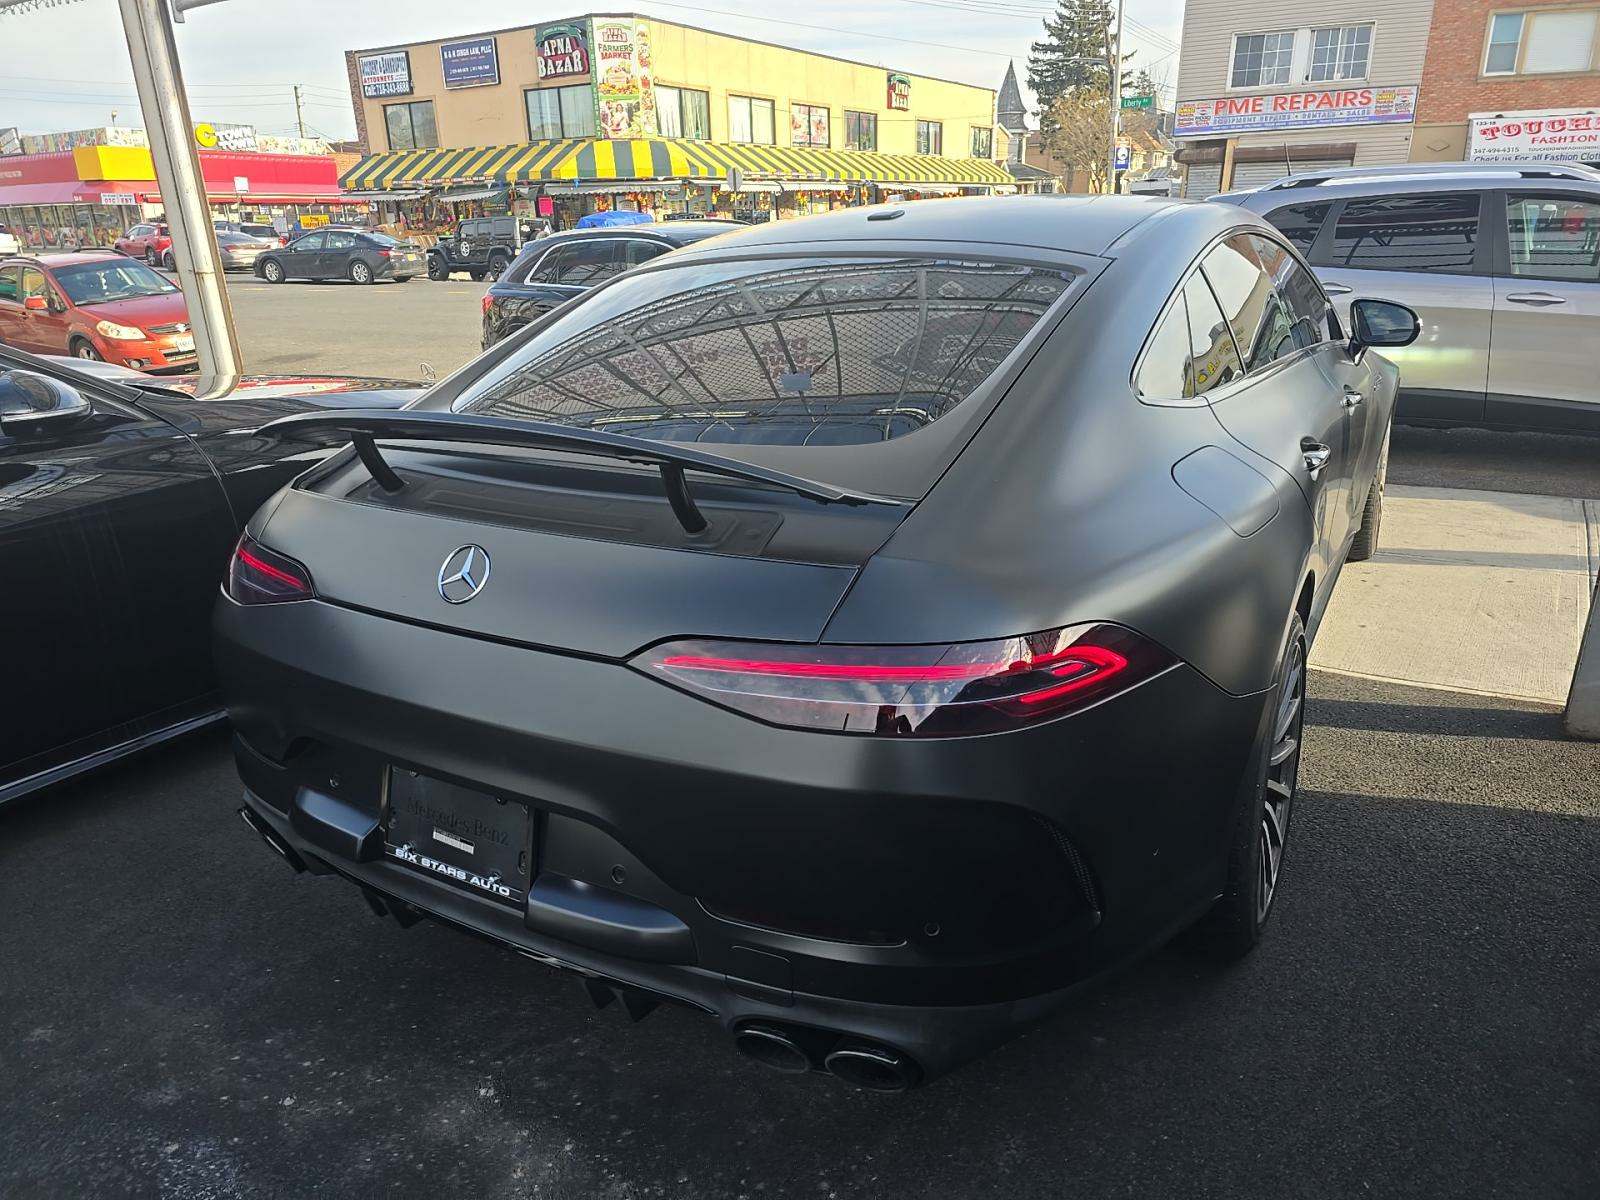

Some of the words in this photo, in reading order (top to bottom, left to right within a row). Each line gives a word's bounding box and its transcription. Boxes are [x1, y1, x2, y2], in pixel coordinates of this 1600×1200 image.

[544, 37, 573, 56] APNA
[598, 43, 634, 52] FARMERS
[601, 52, 632, 60] MARKET
[537, 49, 583, 78] BAZAR
[363, 74, 394, 84] ATTORNEYS
[1124, 99, 1141, 108] Liberty
[1213, 96, 1264, 116] PME
[1273, 89, 1372, 112] REPAIRS
[1213, 116, 1257, 126] EQUIPMENT
[1260, 114, 1291, 122] REPAIRS
[1302, 111, 1336, 120] RENTALS
[1346, 108, 1371, 117] SALES
[195, 123, 218, 148] C
[1531, 134, 1598, 144] FASHION
[1545, 153, 1579, 161] Fashion
[395, 847, 418, 864] SIX
[421, 857, 466, 882] STARS
[470, 875, 511, 897] AUTO
